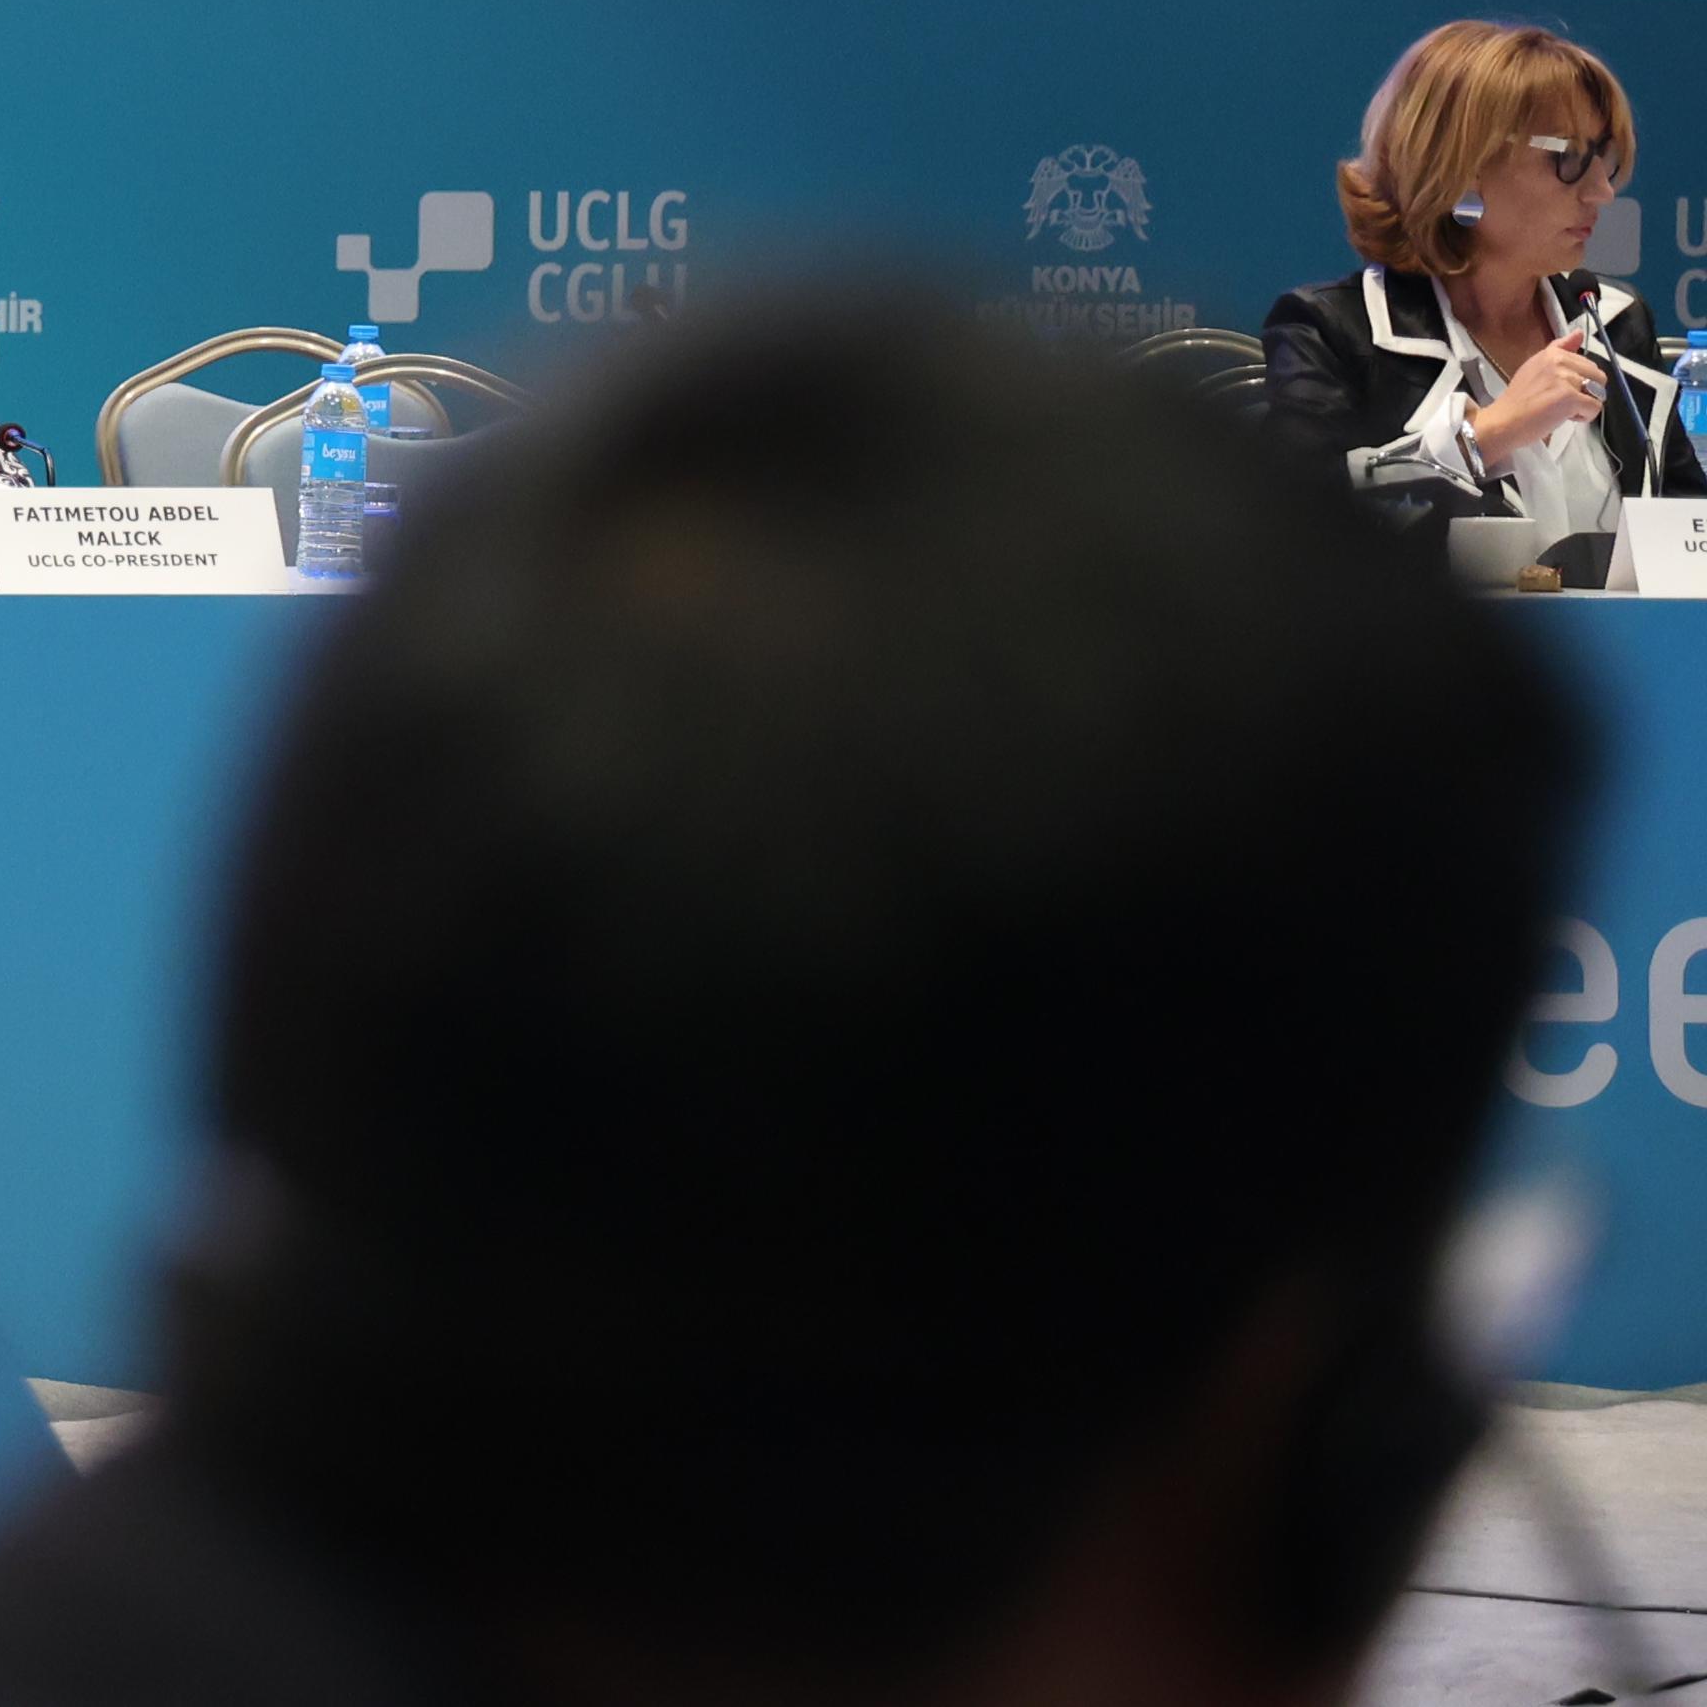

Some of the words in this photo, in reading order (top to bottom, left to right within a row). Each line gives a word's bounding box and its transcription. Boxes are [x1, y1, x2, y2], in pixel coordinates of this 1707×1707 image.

[528, 189, 688, 252] UCLG
[1032, 265, 1142, 294] KONYA
[13, 506, 140, 522] FATIMETOU
[148, 505, 219, 522] ABDEL
[77, 530, 162, 546] MALICK
[27, 554, 76, 568] UCLG
[81, 553, 218, 567] CO-PRESIDENT
